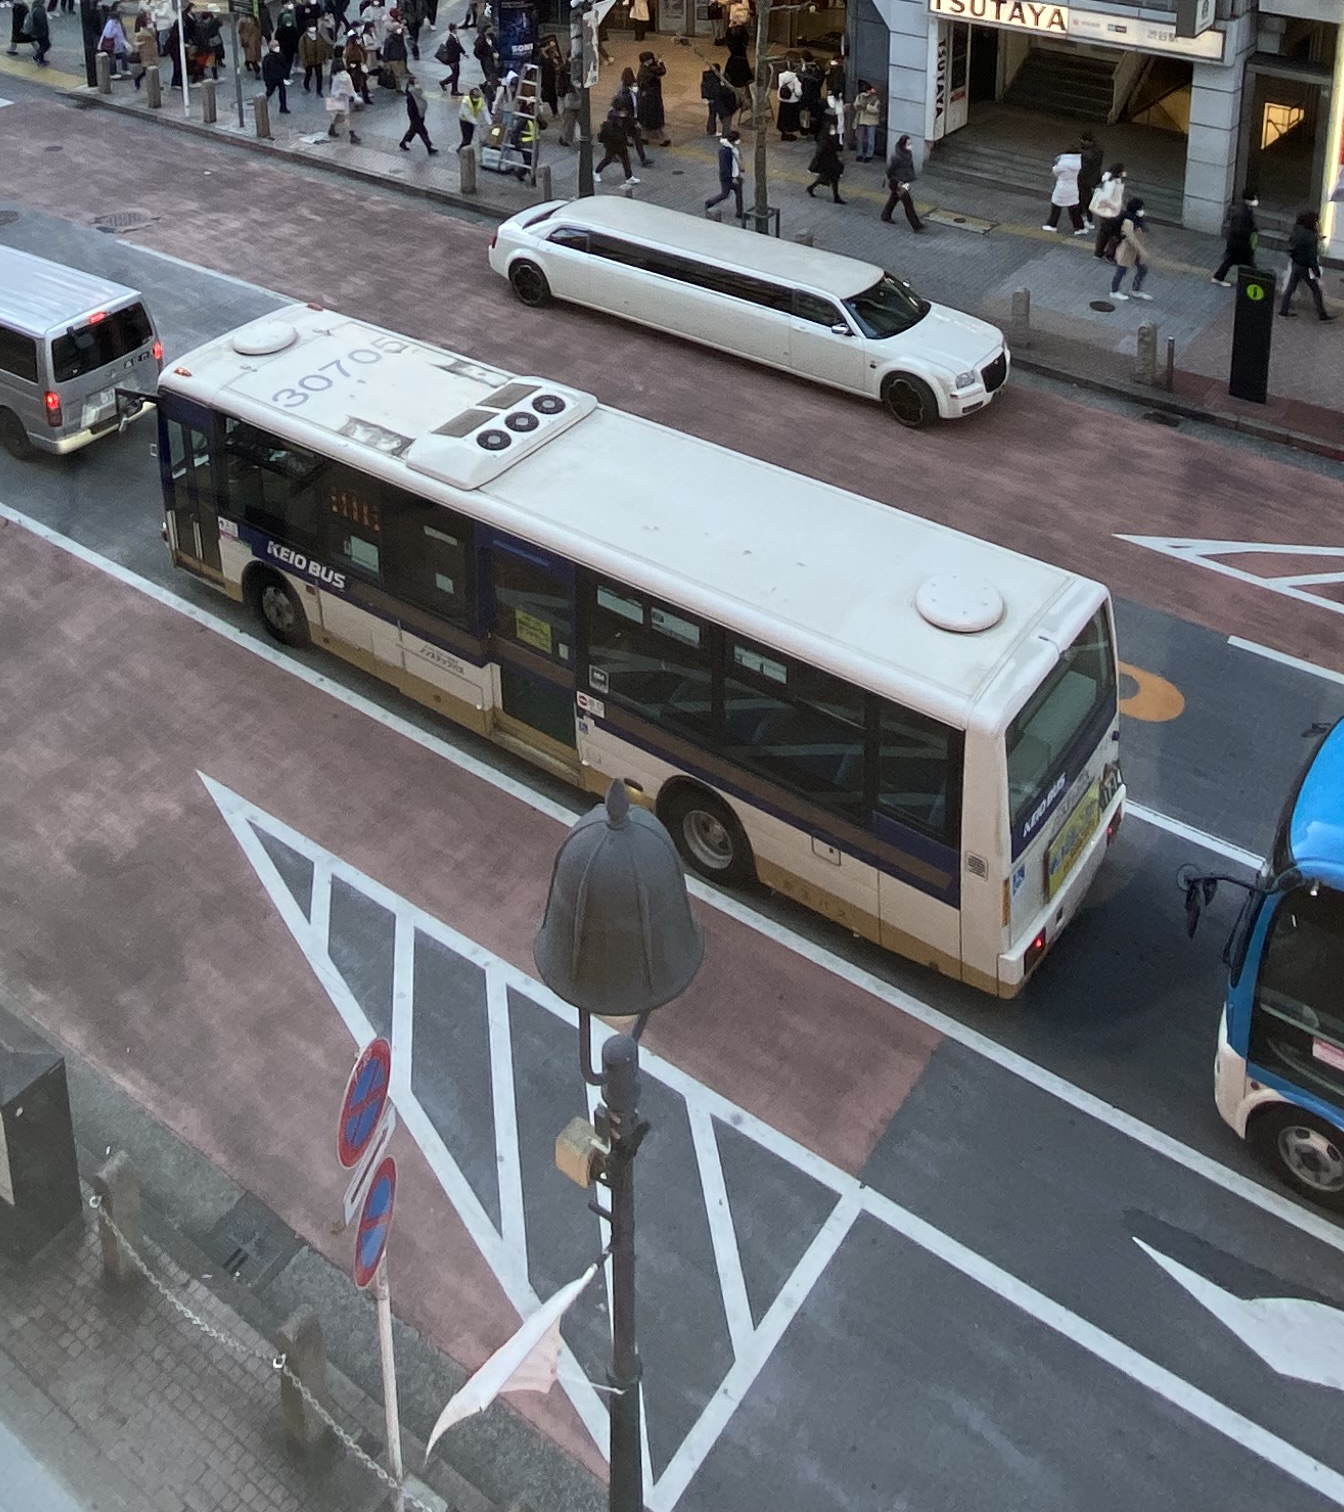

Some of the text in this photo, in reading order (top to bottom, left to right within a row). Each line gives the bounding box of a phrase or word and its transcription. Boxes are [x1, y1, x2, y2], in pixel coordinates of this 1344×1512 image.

[935, 39, 946, 120] TSUTAYA
[272, 335, 408, 408] 30705
[267, 540, 346, 589] KEIO BUS
